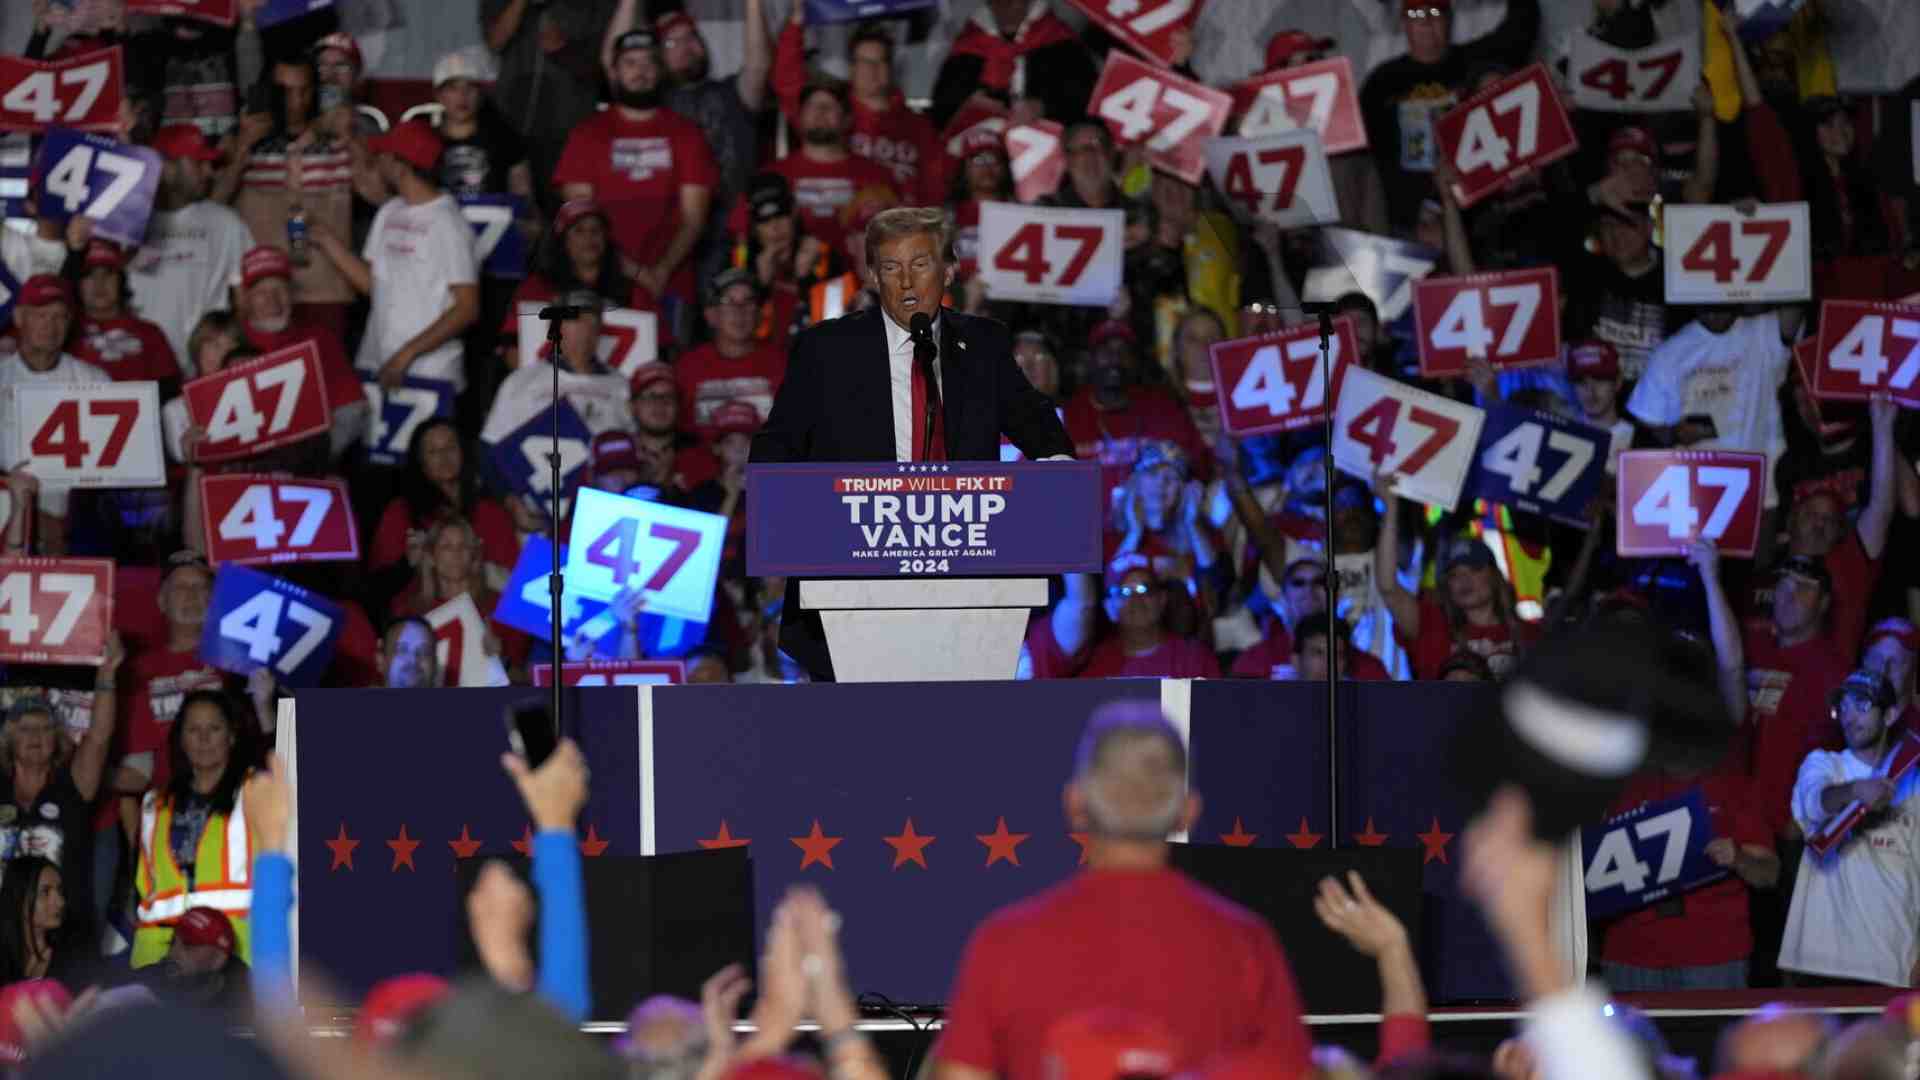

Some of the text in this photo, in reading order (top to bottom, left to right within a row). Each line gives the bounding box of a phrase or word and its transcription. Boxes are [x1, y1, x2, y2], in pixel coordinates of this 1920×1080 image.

[2, 61, 110, 122] 47
[1238, 72, 1339, 141] 47
[1579, 51, 1685, 99] 47
[1100, 77, 1212, 152] 47
[1455, 82, 1540, 174] 47
[46, 144, 146, 220] 47
[1006, 125, 1059, 183] 7
[1226, 146, 1307, 211] 47
[461, 205, 513, 266] 7
[992, 224, 1105, 286] 47
[1681, 218, 1792, 285] 47
[1431, 283, 1543, 358] 47
[1828, 313, 1920, 389] 47
[205, 359, 307, 444] 47
[1231, 333, 1340, 415] 47
[31, 399, 140, 469] 47
[1348, 396, 1461, 476] 47
[1482, 421, 1596, 502] 47
[218, 484, 333, 550] 47
[842, 477, 1006, 491] TRUMP WILL FIX IT
[842, 494, 1006, 523] TRUMP
[1632, 464, 1751, 540] 47
[585, 516, 702, 592] 47
[852, 550, 880, 558] MAKE
[928, 549, 959, 557] GREAT
[962, 549, 996, 557] AGAIN!
[861, 524, 987, 547] VANCE
[900, 560, 949, 573] 2024
[0, 571, 96, 645] 47
[220, 590, 333, 675] 47
[1585, 806, 1692, 895] 47
